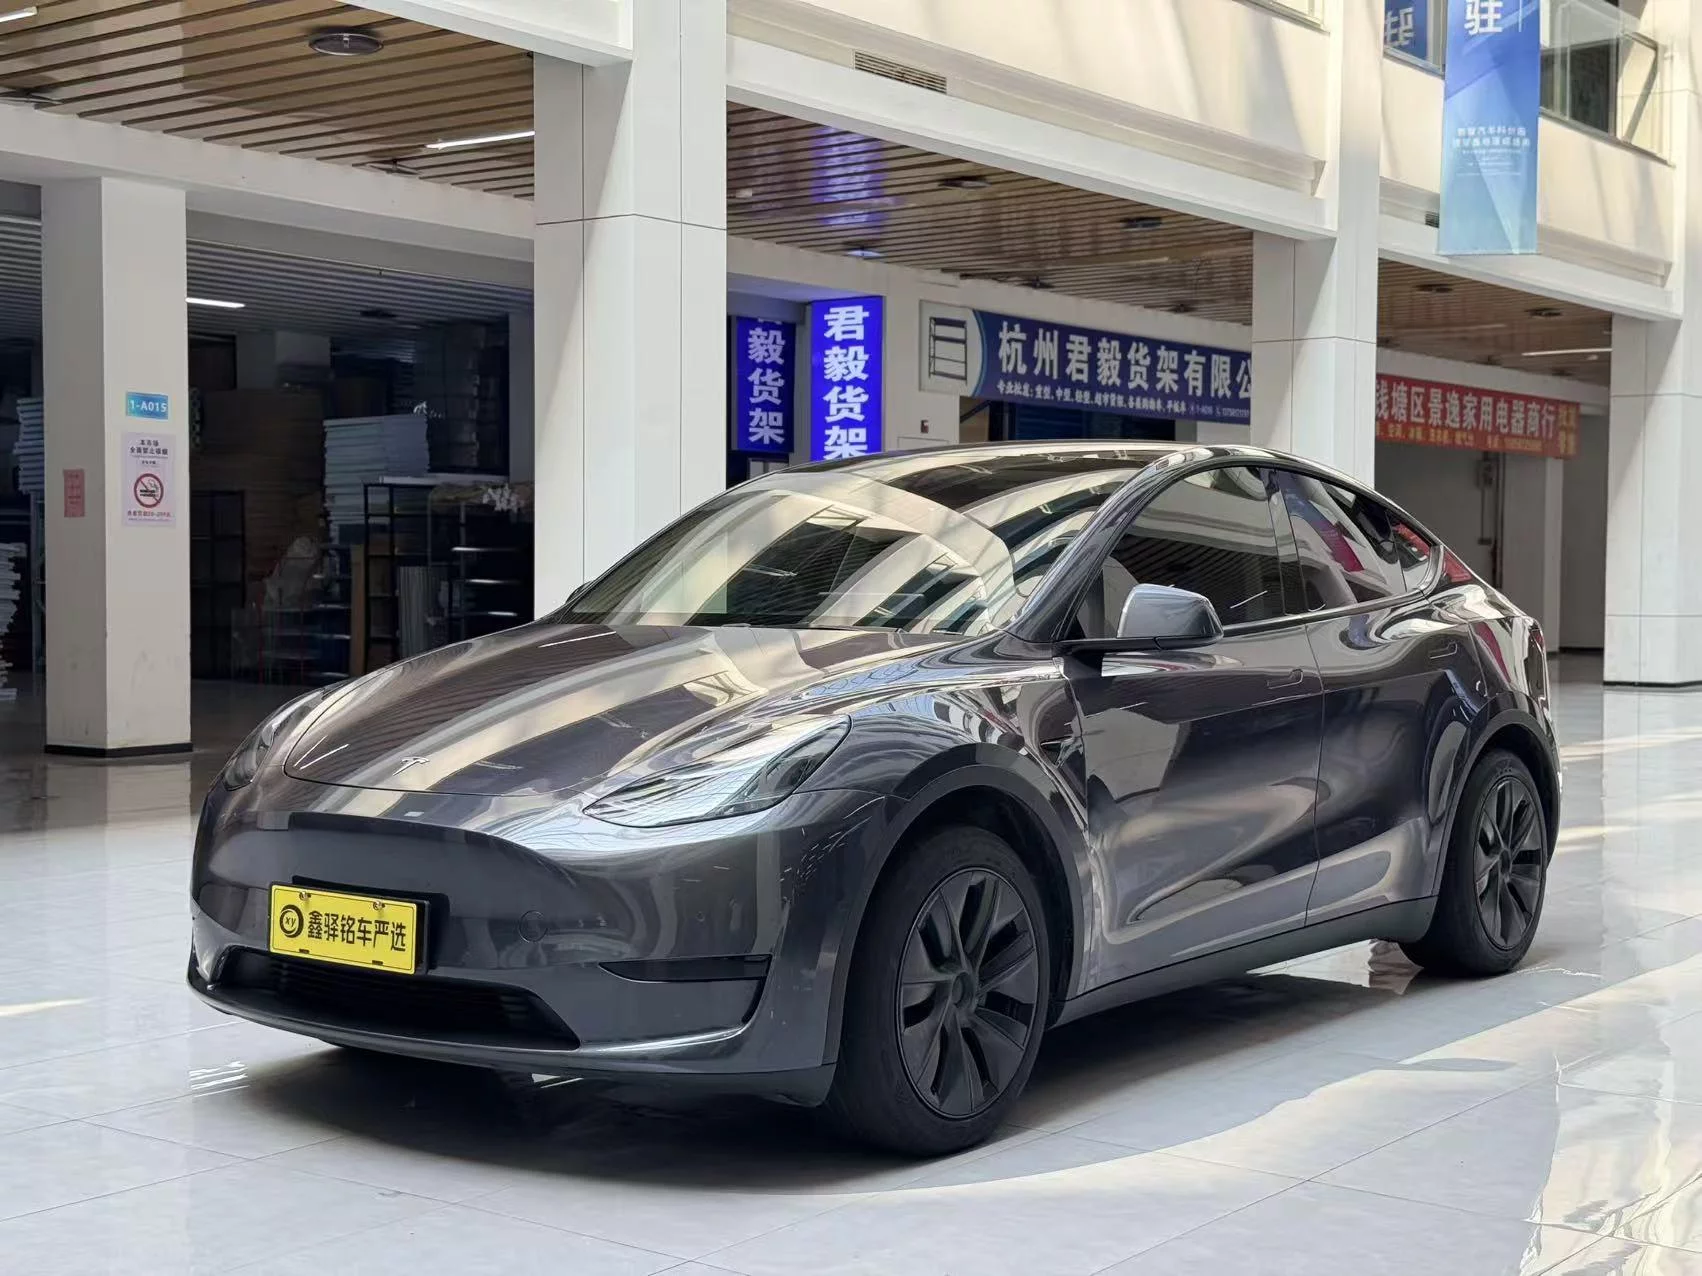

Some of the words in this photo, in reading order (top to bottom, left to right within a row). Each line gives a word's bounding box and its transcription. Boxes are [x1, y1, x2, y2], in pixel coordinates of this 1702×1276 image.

[748, 318, 786, 445] 毅货架
[823, 305, 870, 460] 君毅货架
[998, 320, 1250, 399] 杭州君毅货架有限公
[129, 400, 168, 412] 1-A015
[307, 910, 407, 952] 鑫驿铭车严选
